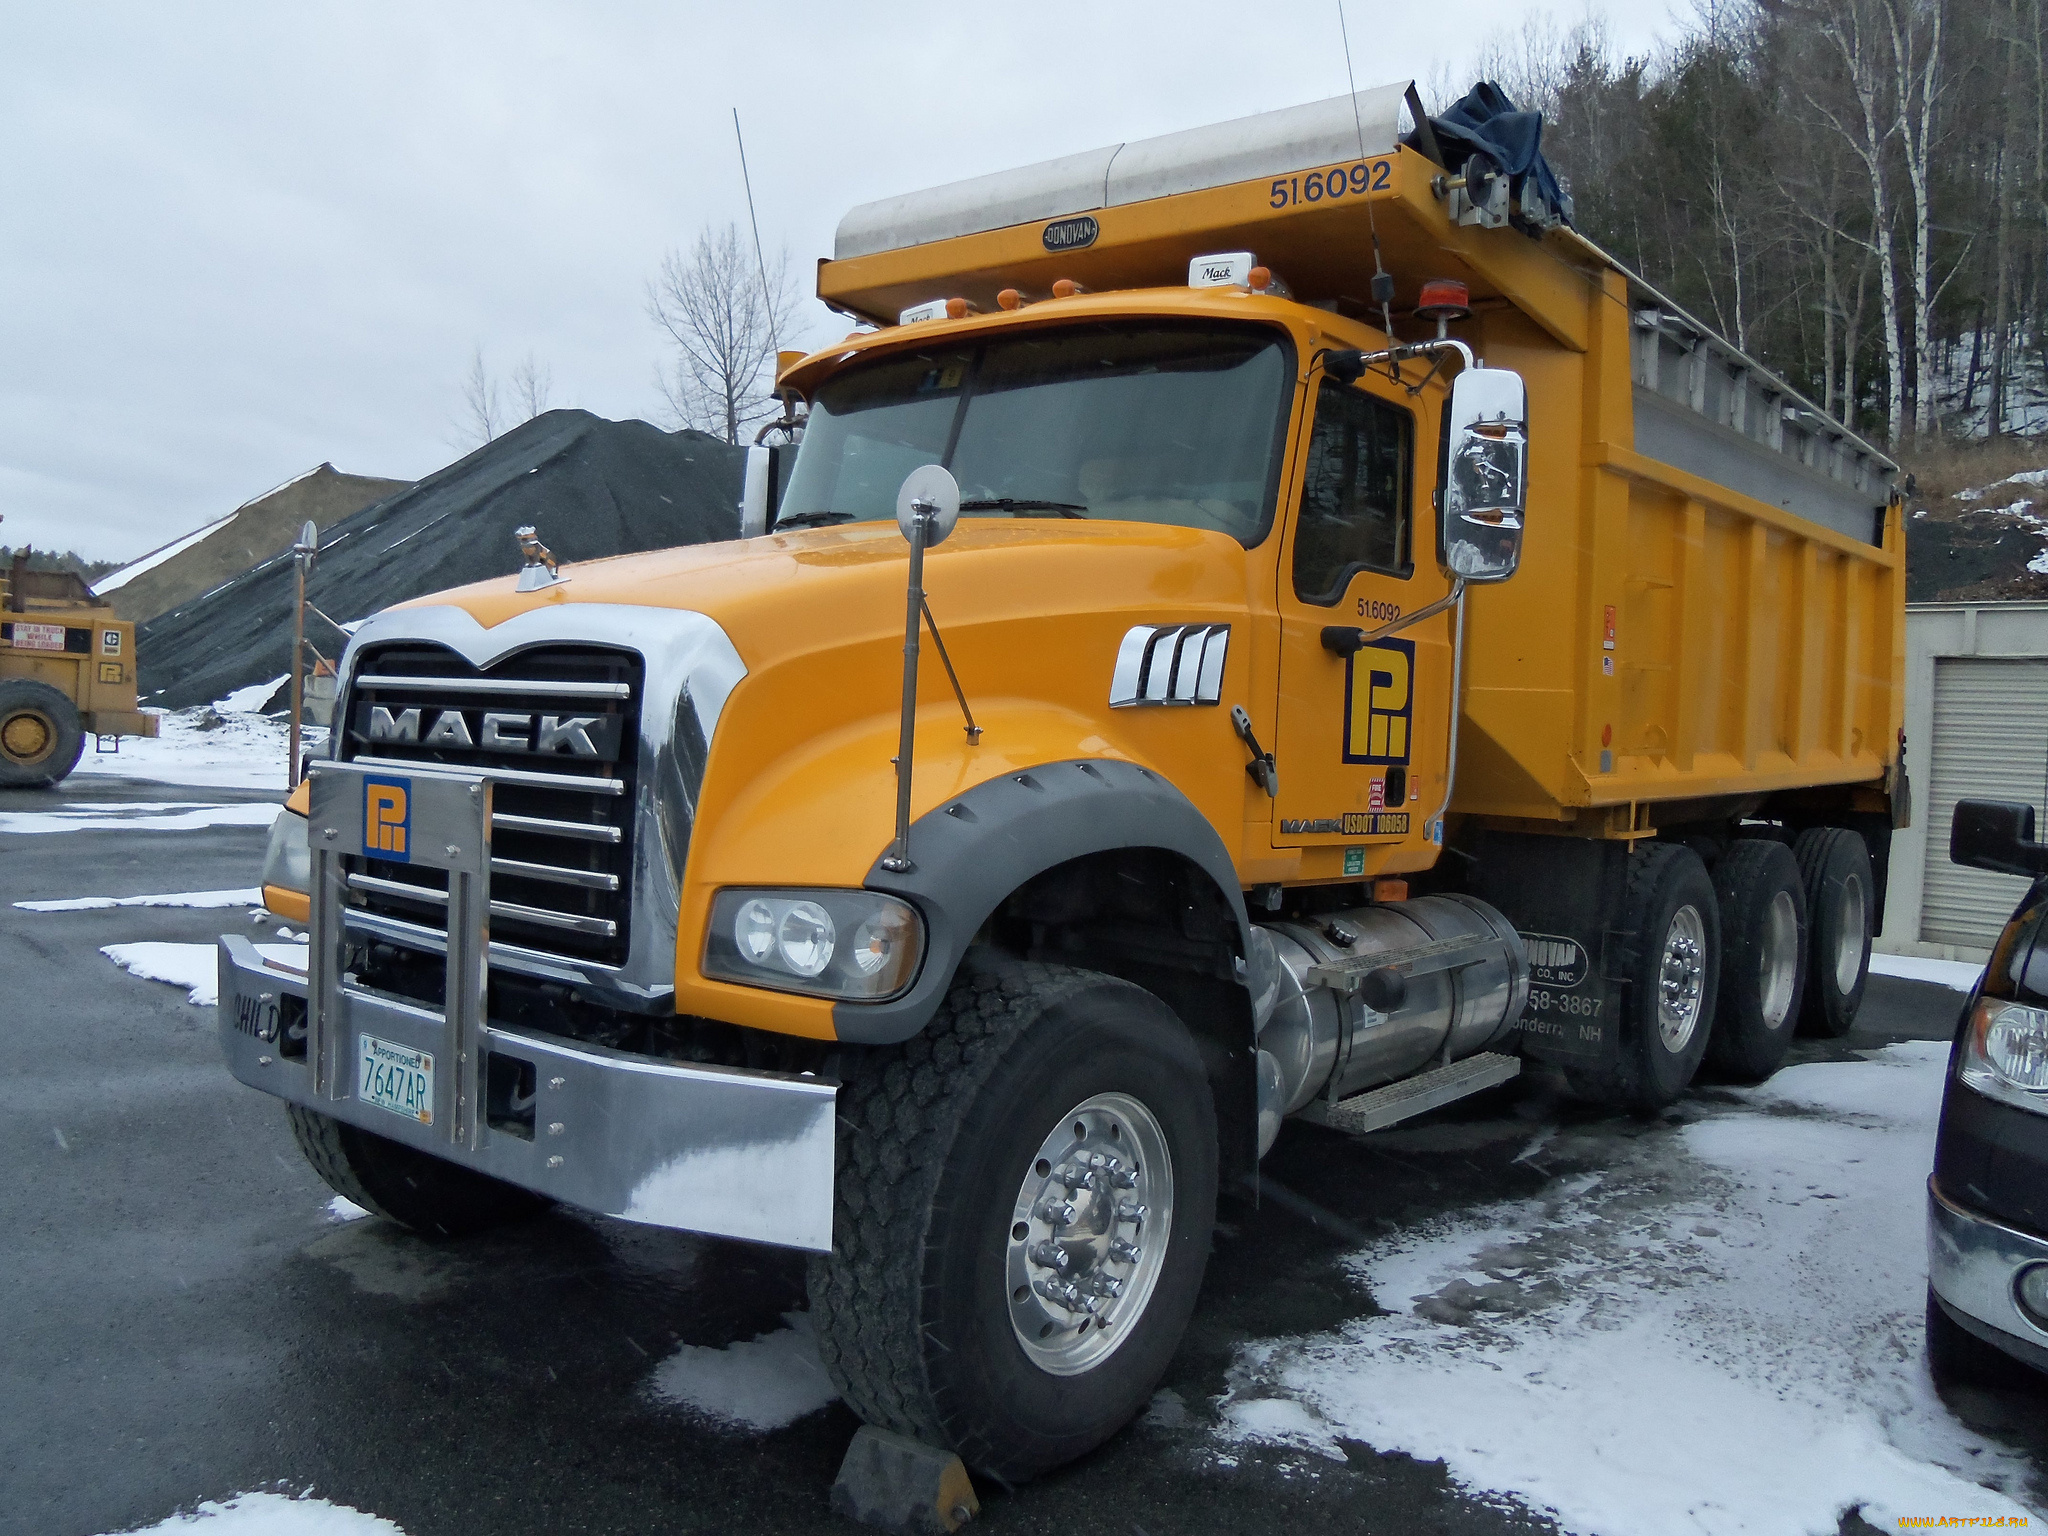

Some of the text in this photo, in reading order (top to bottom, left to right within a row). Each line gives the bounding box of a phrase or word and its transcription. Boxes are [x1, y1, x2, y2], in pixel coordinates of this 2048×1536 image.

[1269, 160, 1391, 209] 51.6092
[1047, 221, 1091, 245] DONOVAN
[1202, 266, 1231, 281] Mack
[370, 706, 604, 755] MACK
[1281, 818, 1342, 834] MACK
[1344, 814, 1374, 834] USDOT
[1579, 1025, 1602, 1042] NH
[373, 1046, 421, 1069] APPORTIONED
[365, 1056, 426, 1111] 7647AR
